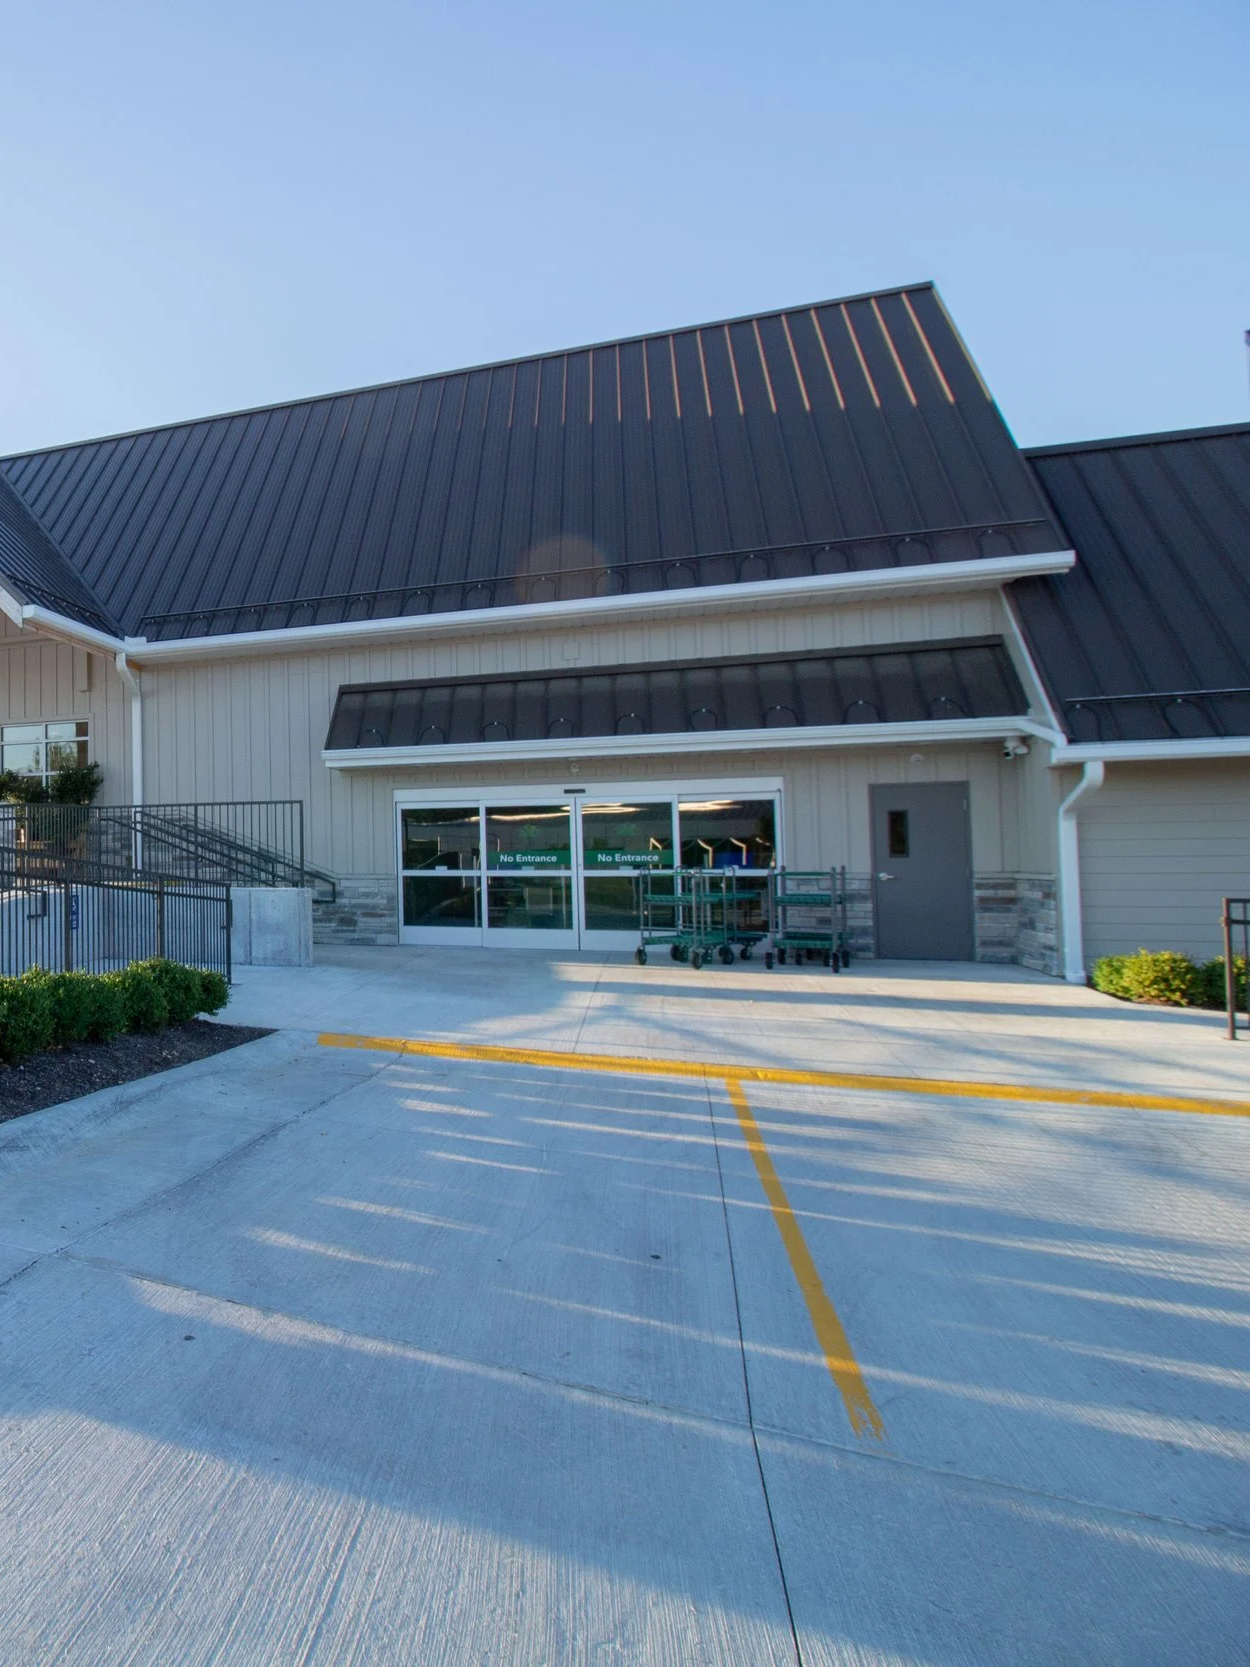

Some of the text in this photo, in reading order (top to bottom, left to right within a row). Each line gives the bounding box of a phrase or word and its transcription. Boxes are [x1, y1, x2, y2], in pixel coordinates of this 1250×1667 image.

[500, 854, 557, 862] No Entrance
[598, 853, 659, 862] No Entrance
